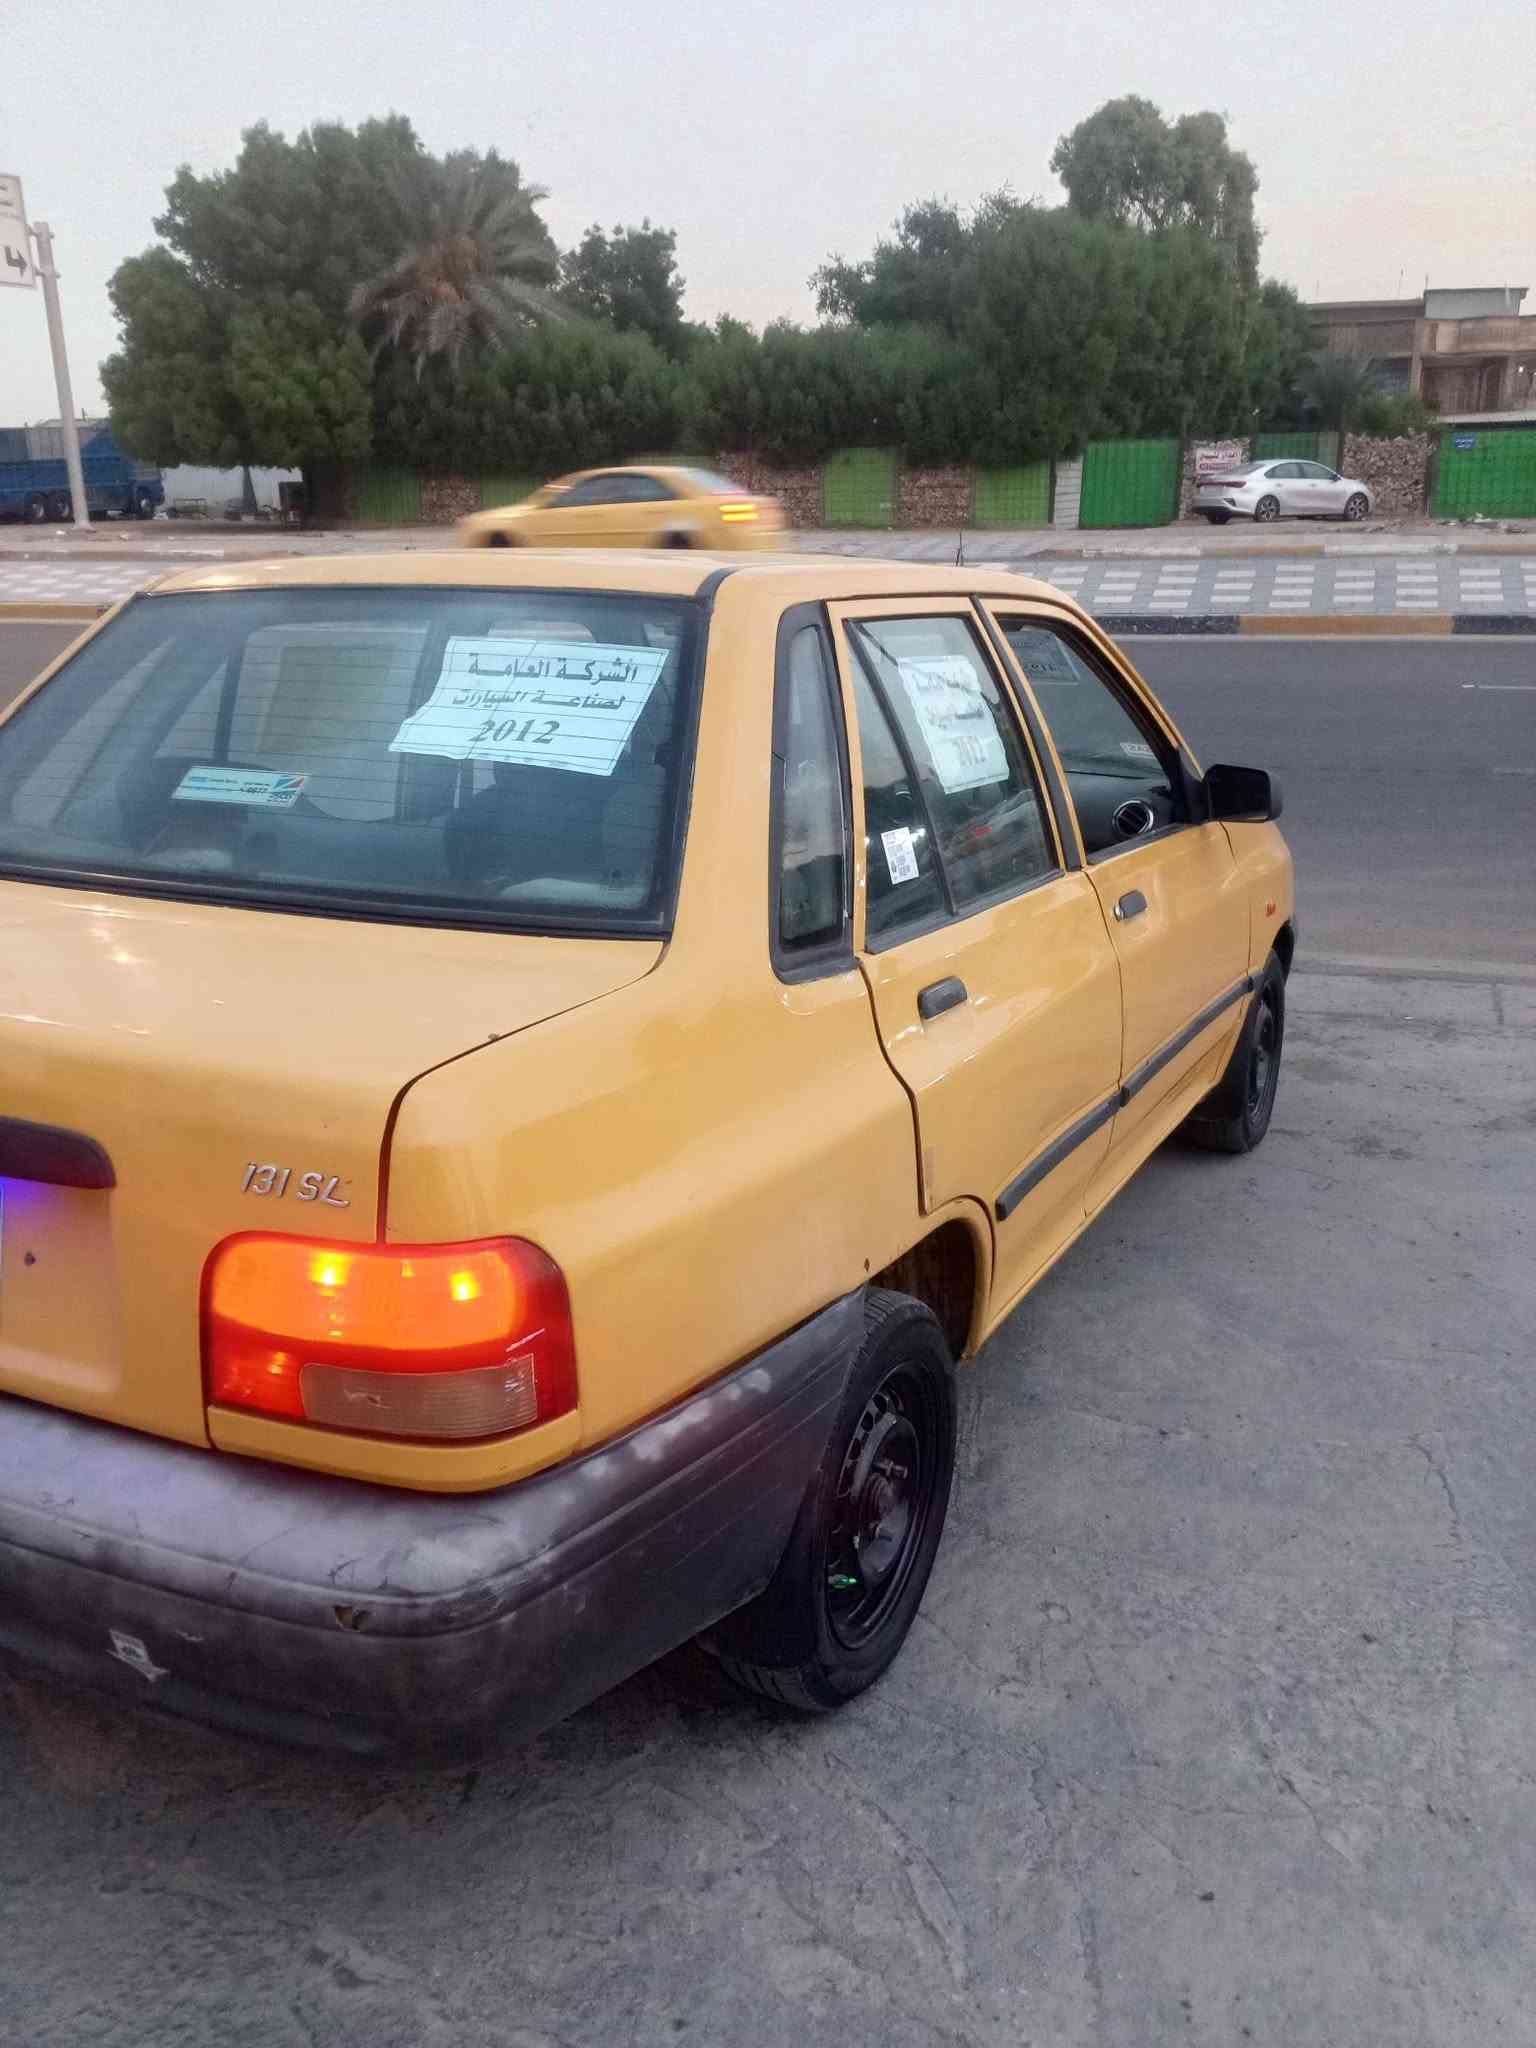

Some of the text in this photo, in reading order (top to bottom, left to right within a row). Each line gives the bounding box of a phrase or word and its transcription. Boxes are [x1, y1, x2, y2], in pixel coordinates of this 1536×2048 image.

[467, 652, 640, 686] الشركة العامة
[451, 688, 627, 710] لصناعة السيارات
[467, 718, 561, 744] 2012
[241, 1160, 351, 1209] 131 SL
